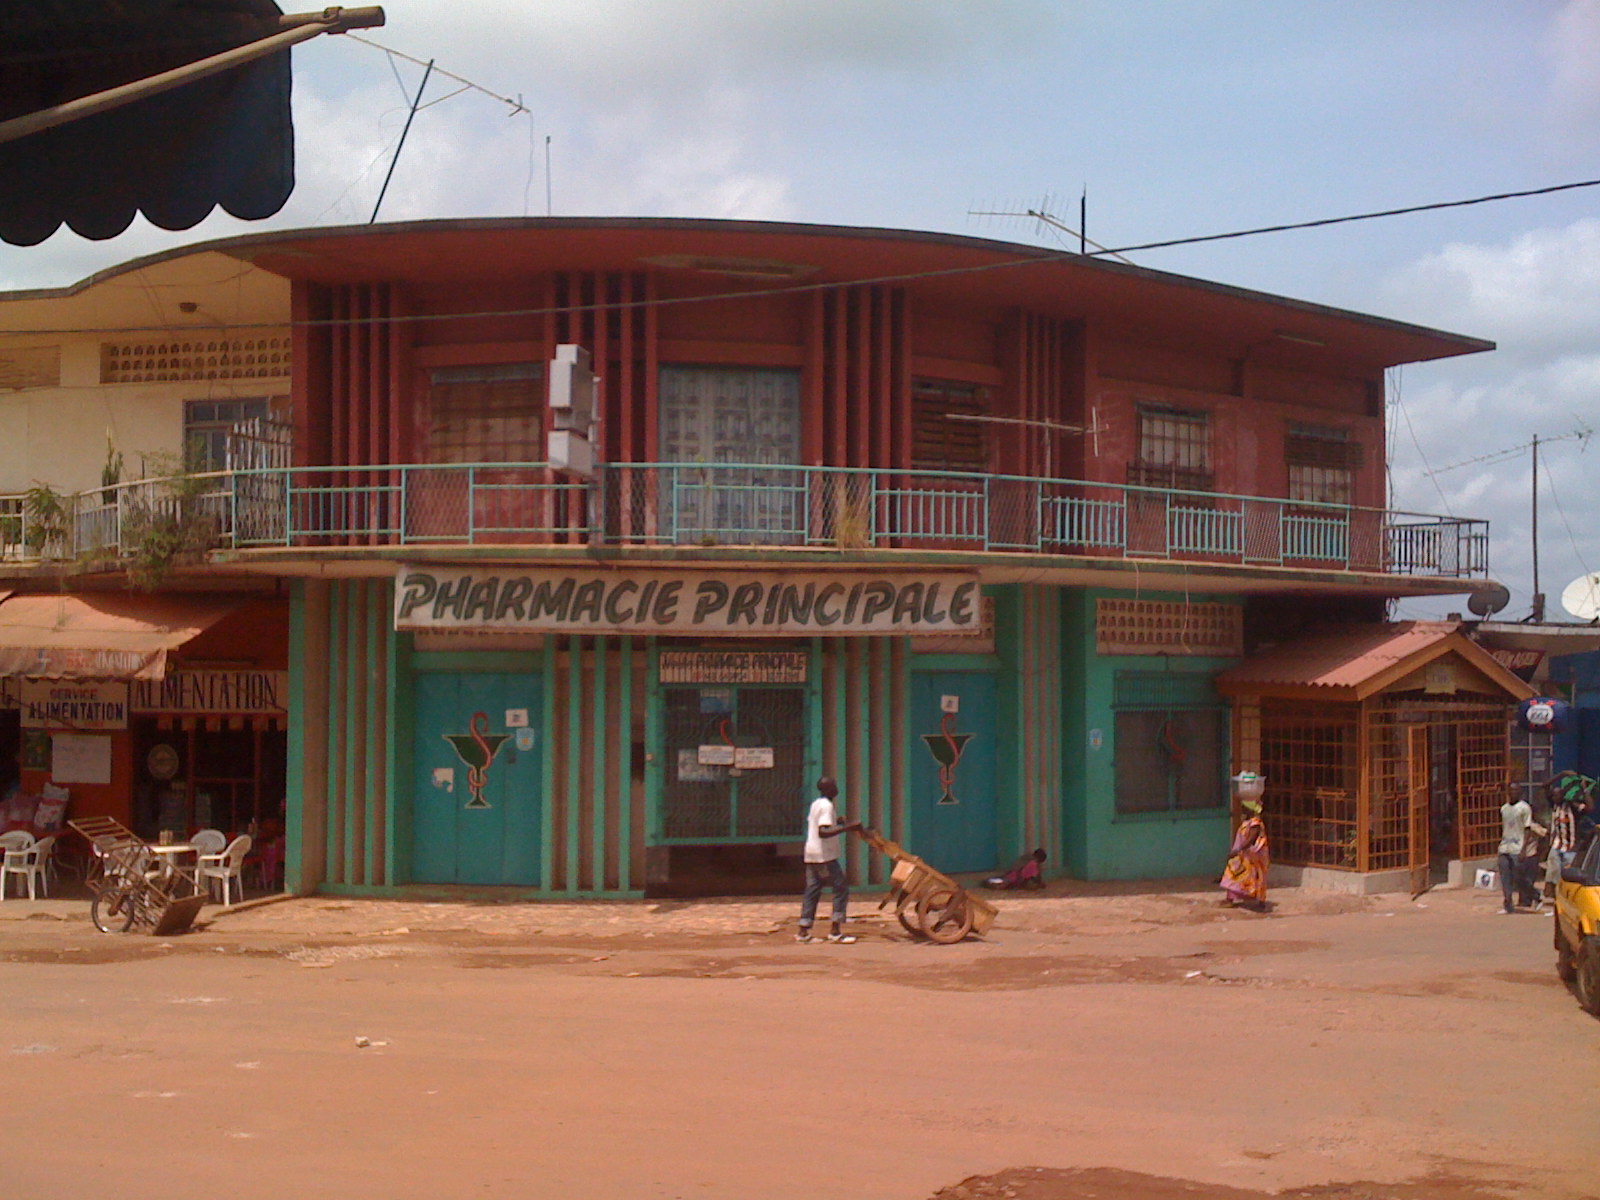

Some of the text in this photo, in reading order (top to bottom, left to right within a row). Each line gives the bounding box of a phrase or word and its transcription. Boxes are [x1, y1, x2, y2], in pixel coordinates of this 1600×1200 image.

[401, 573, 979, 626] PHARMACIE PRINCIPALE
[134, 673, 278, 709] ALIMENTATION
[29, 702, 124, 721] ALIMENTATION
